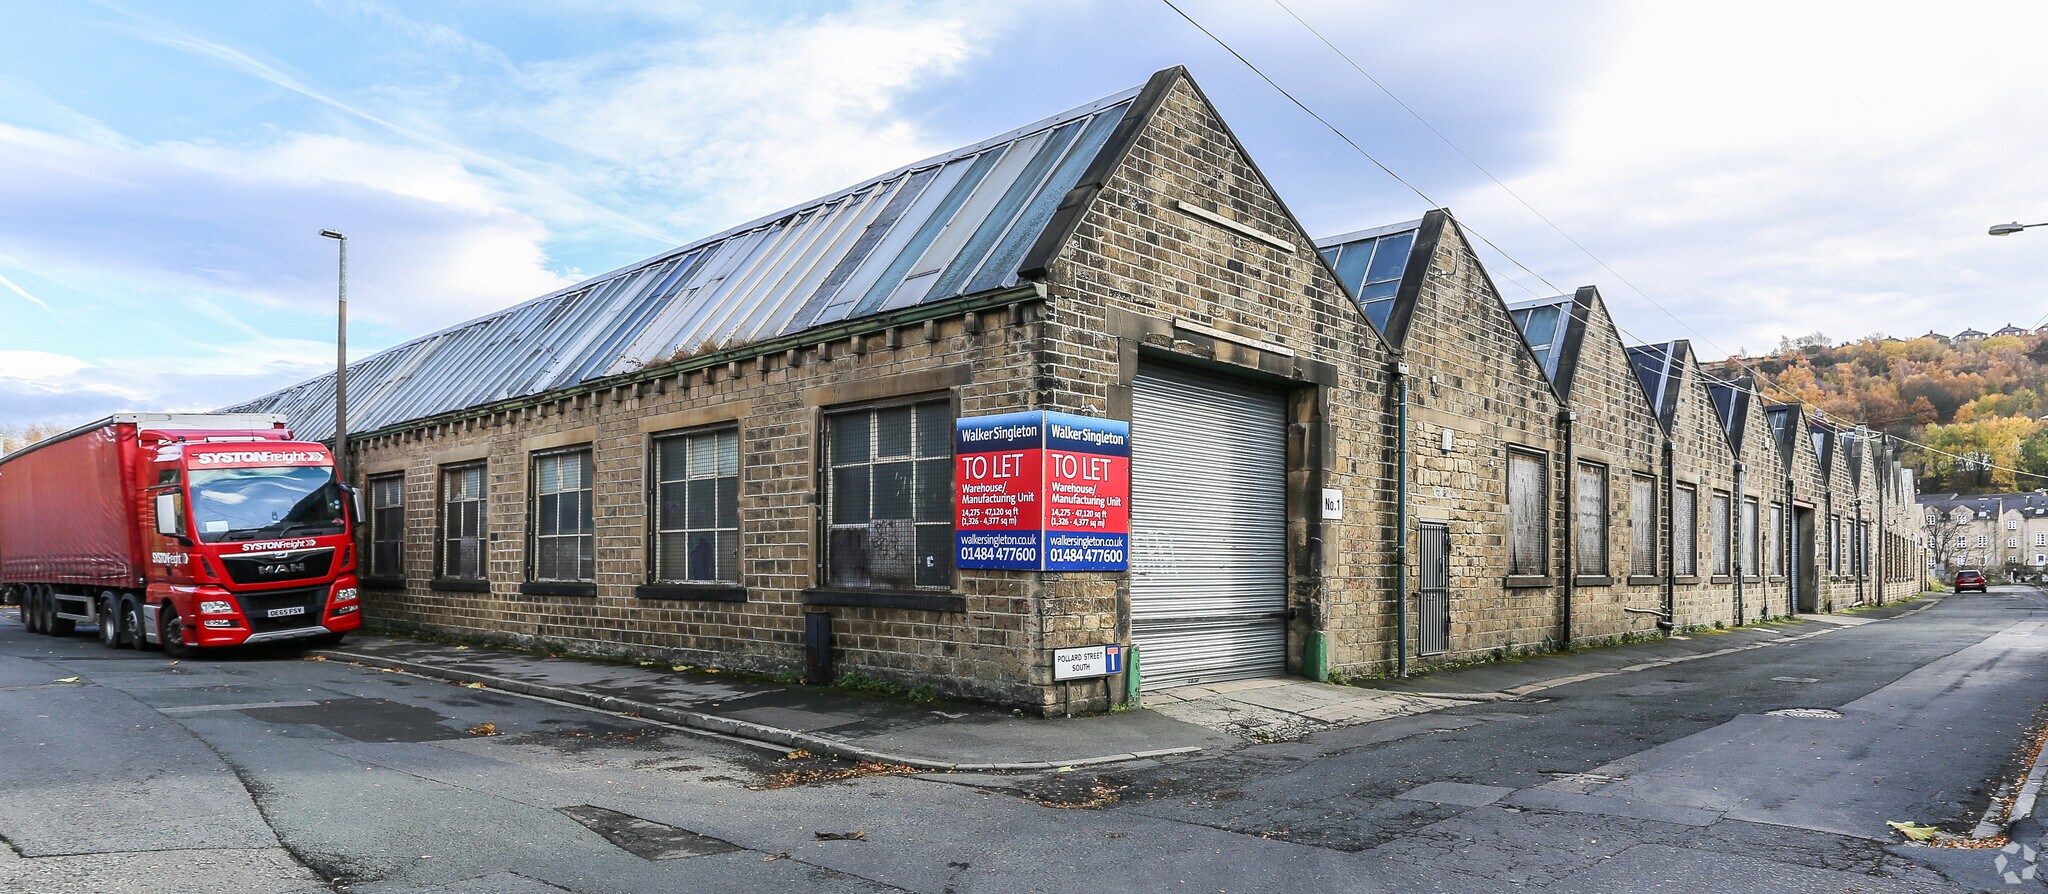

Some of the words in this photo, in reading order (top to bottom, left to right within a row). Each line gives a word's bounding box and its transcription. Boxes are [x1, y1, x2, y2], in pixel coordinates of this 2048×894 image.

[962, 425, 1037, 441] WalkerSingleton
[1051, 424, 1124, 446] WalkerSingleton
[962, 456, 987, 480] TO
[993, 453, 1024, 478] LET
[1051, 453, 1078, 479] TO
[1083, 456, 1112, 481] LET
[962, 481, 1007, 494] Warehouse/
[1051, 481, 1097, 495] Warehouse/
[962, 493, 1016, 505] Manufacturing
[1017, 491, 1035, 502] Unit
[1051, 493, 1105, 508] Manufacturing
[1106, 496, 1121, 507] Unit
[1325, 498, 1340, 511] No.1
[962, 508, 980, 517] 14,275
[985, 508, 1004, 517] 47,120
[1005, 509, 1012, 517] sq
[1013, 506, 1019, 516] ft
[1051, 508, 1070, 517] 14,275
[1075, 509, 1093, 518] 47,120
[1094, 511, 1101, 520] sq
[1101, 510, 1107, 518] ft
[961, 517, 979, 526] (1,326
[983, 517, 999, 526] 4,377
[1001, 518, 1008, 526] sq
[1008, 516, 1017, 526] m)
[1051, 517, 1069, 527] (1,326
[1073, 518, 1089, 527] 4,377
[1090, 520, 1097, 528] sq
[1097, 518, 1105, 528] m)
[961, 534, 1037, 548] walkersingleton.co.uk
[1050, 534, 1123, 549] walkersingleton.co.uk
[961, 547, 994, 560] 01484
[996, 547, 1036, 561] 477600
[1050, 548, 1083, 562] 01484
[1085, 549, 1123, 562] 477600
[258, 563, 305, 574] MAN
[1058, 654, 1082, 662] POLLARD
[1084, 652, 1103, 660] STREET
